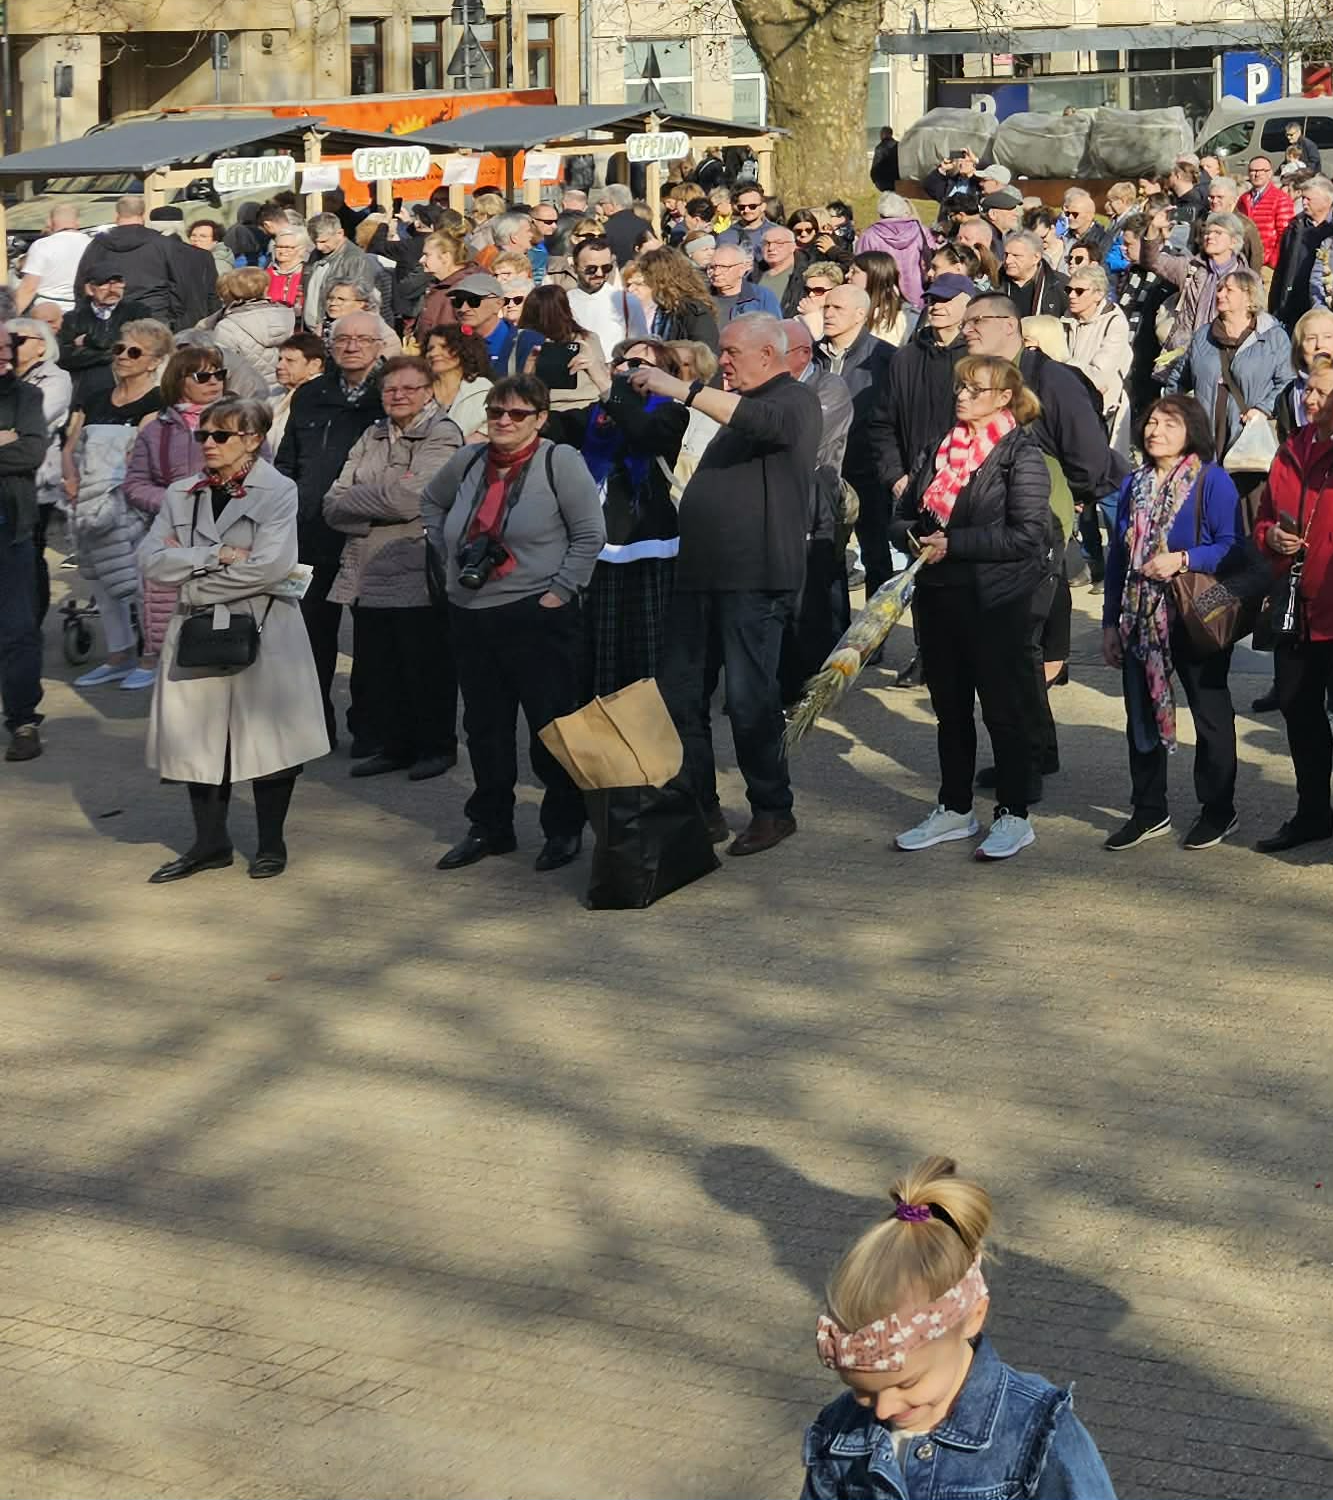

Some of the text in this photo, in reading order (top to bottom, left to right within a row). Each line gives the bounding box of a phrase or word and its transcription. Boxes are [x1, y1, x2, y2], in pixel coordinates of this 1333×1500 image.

[1246, 62, 1270, 105] P
[626, 133, 687, 160] CEPELINY
[214, 159, 292, 187] CEPELINY
[355, 149, 426, 177] CEPELINY
